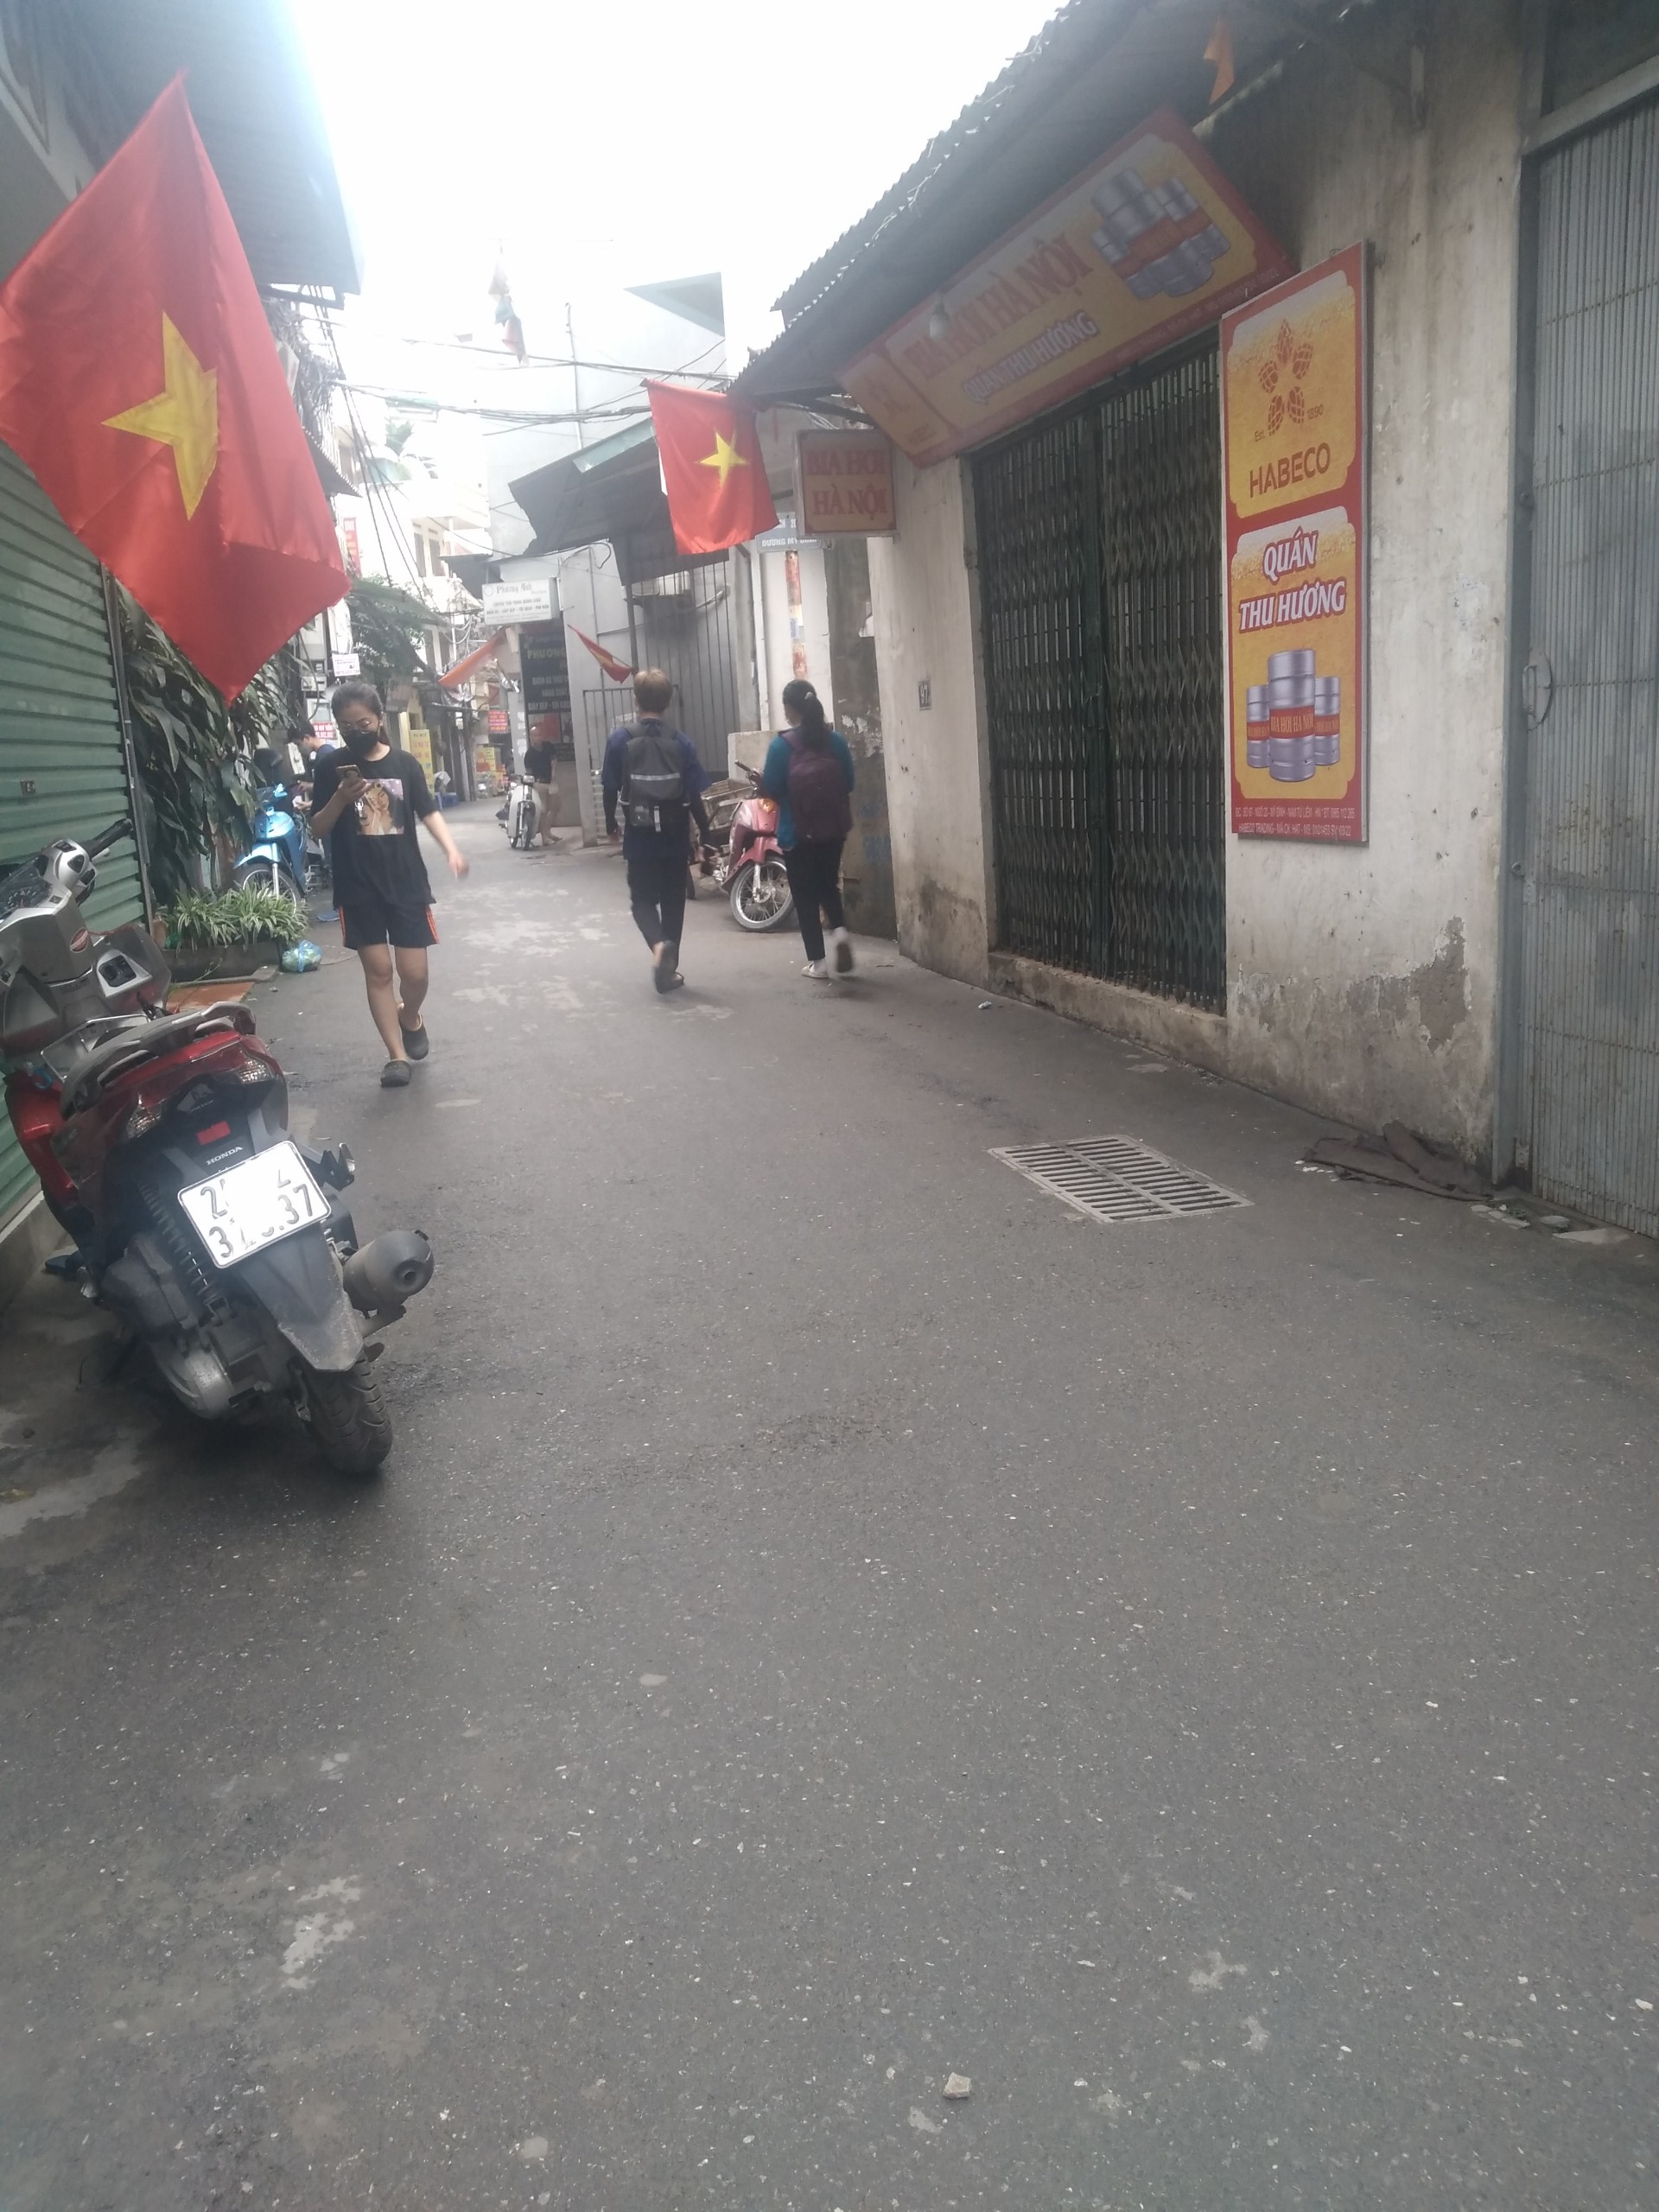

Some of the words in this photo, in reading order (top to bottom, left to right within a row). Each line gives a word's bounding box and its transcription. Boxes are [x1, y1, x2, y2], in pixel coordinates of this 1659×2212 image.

[999, 347, 1038, 380] THU
[1249, 442, 1330, 498] HABECO
[812, 483, 846, 515] HÀ
[847, 483, 887, 520] NỘI
[1263, 528, 1318, 582] QUÁN
[1239, 596, 1275, 631] THU
[1276, 579, 1345, 625] HƯƠNG
[206, 1146, 244, 1166] HONDA
